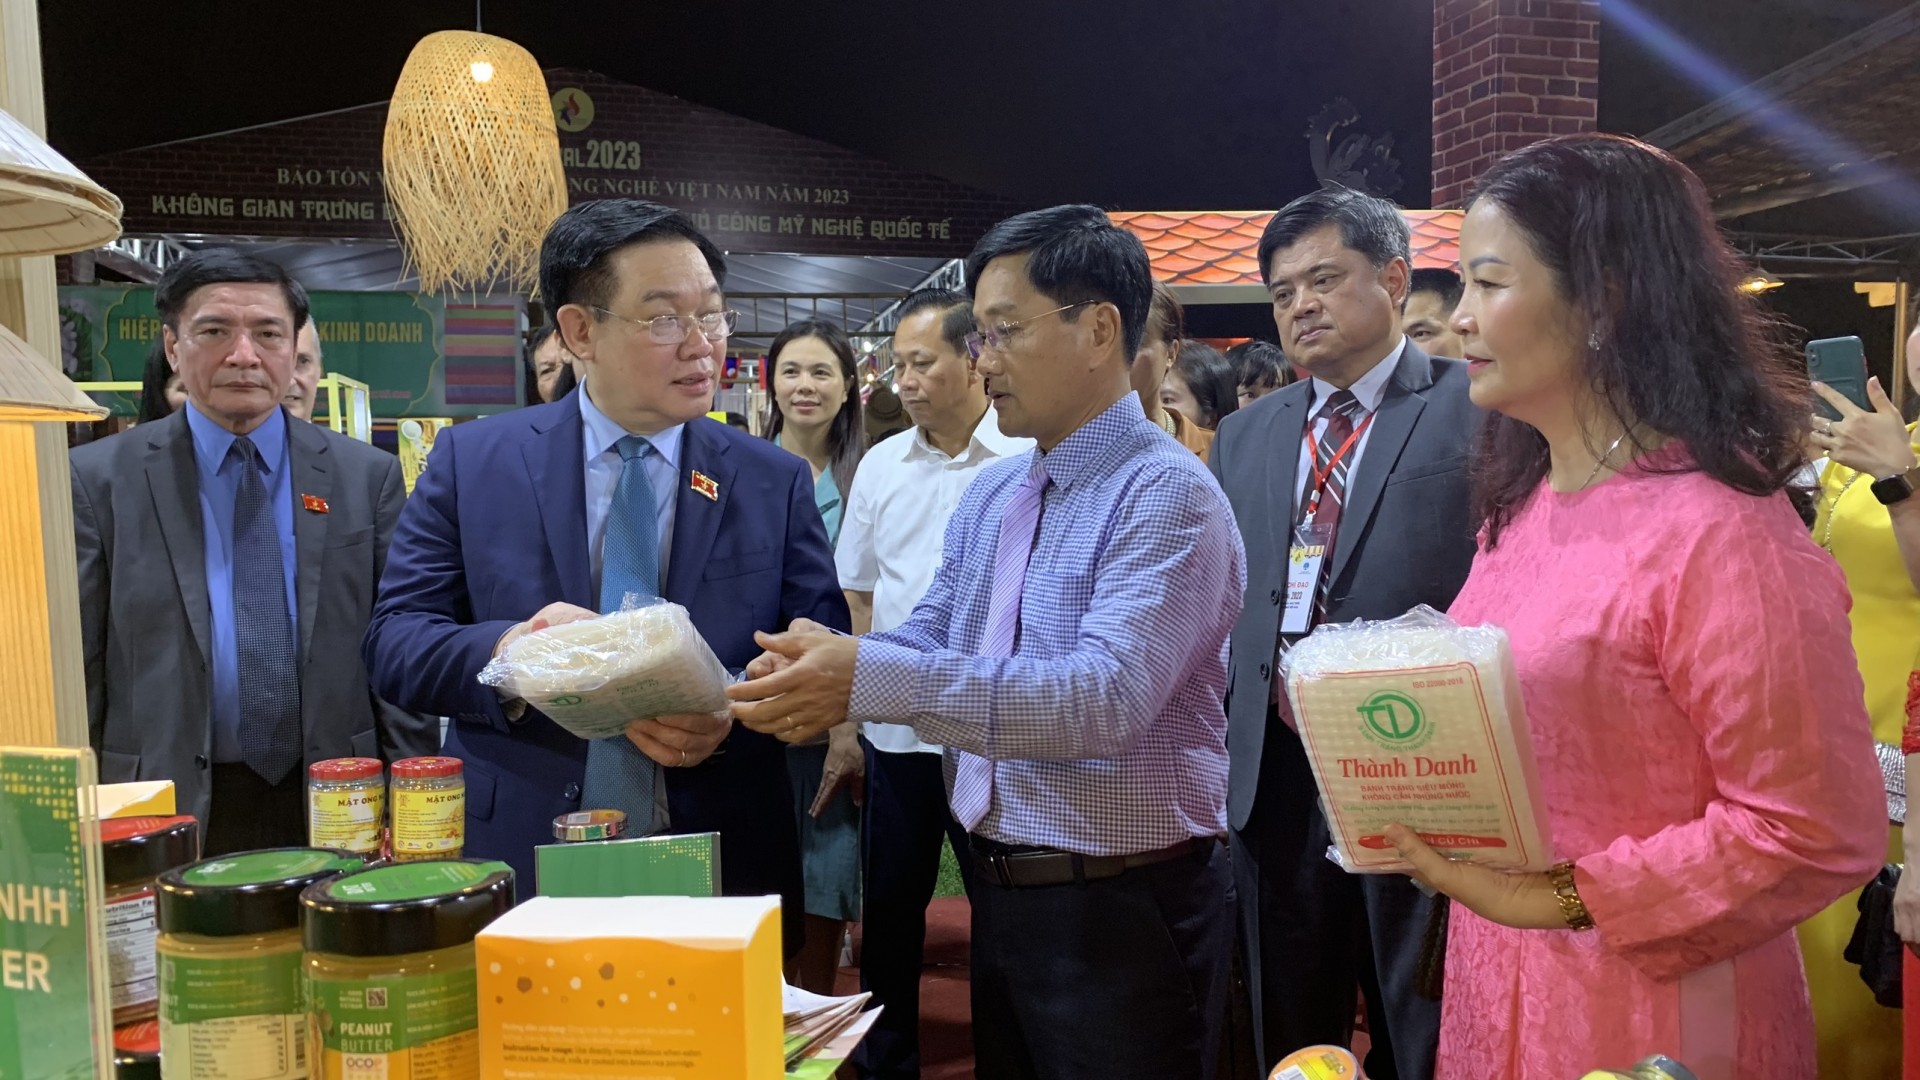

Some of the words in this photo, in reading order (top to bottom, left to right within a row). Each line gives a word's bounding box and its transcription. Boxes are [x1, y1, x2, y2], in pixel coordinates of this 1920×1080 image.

[586, 139, 641, 170] 2023
[277, 167, 322, 185] BẢO
[569, 177, 599, 194] NG
[665, 179, 711, 201] VIỆT
[716, 184, 760, 202] NAM
[765, 183, 810, 203] NĂM
[814, 188, 850, 205] 2023
[152, 194, 234, 217] KHÔNG
[242, 198, 294, 219] GIAN
[301, 198, 375, 221] TRƯNG
[717, 210, 771, 233] CÔNG
[778, 213, 805, 235] MỸ
[811, 216, 864, 240] NGHỆ
[870, 215, 922, 241] QUỐC
[928, 216, 952, 240] TẾ
[119, 314, 161, 345] HIỆP
[319, 321, 361, 343] KINH
[365, 321, 423, 344] DOANH
[1412, 680, 1426, 689] ISO
[1337, 756, 1408, 779] Thành
[1413, 753, 1478, 777] Danh
[361, 795, 378, 804] ONG
[447, 793, 461, 802] ONG
[105, 902, 140, 914] utrition
[340, 1022, 394, 1037] PEANUT
[340, 1038, 394, 1053] BUTTER
